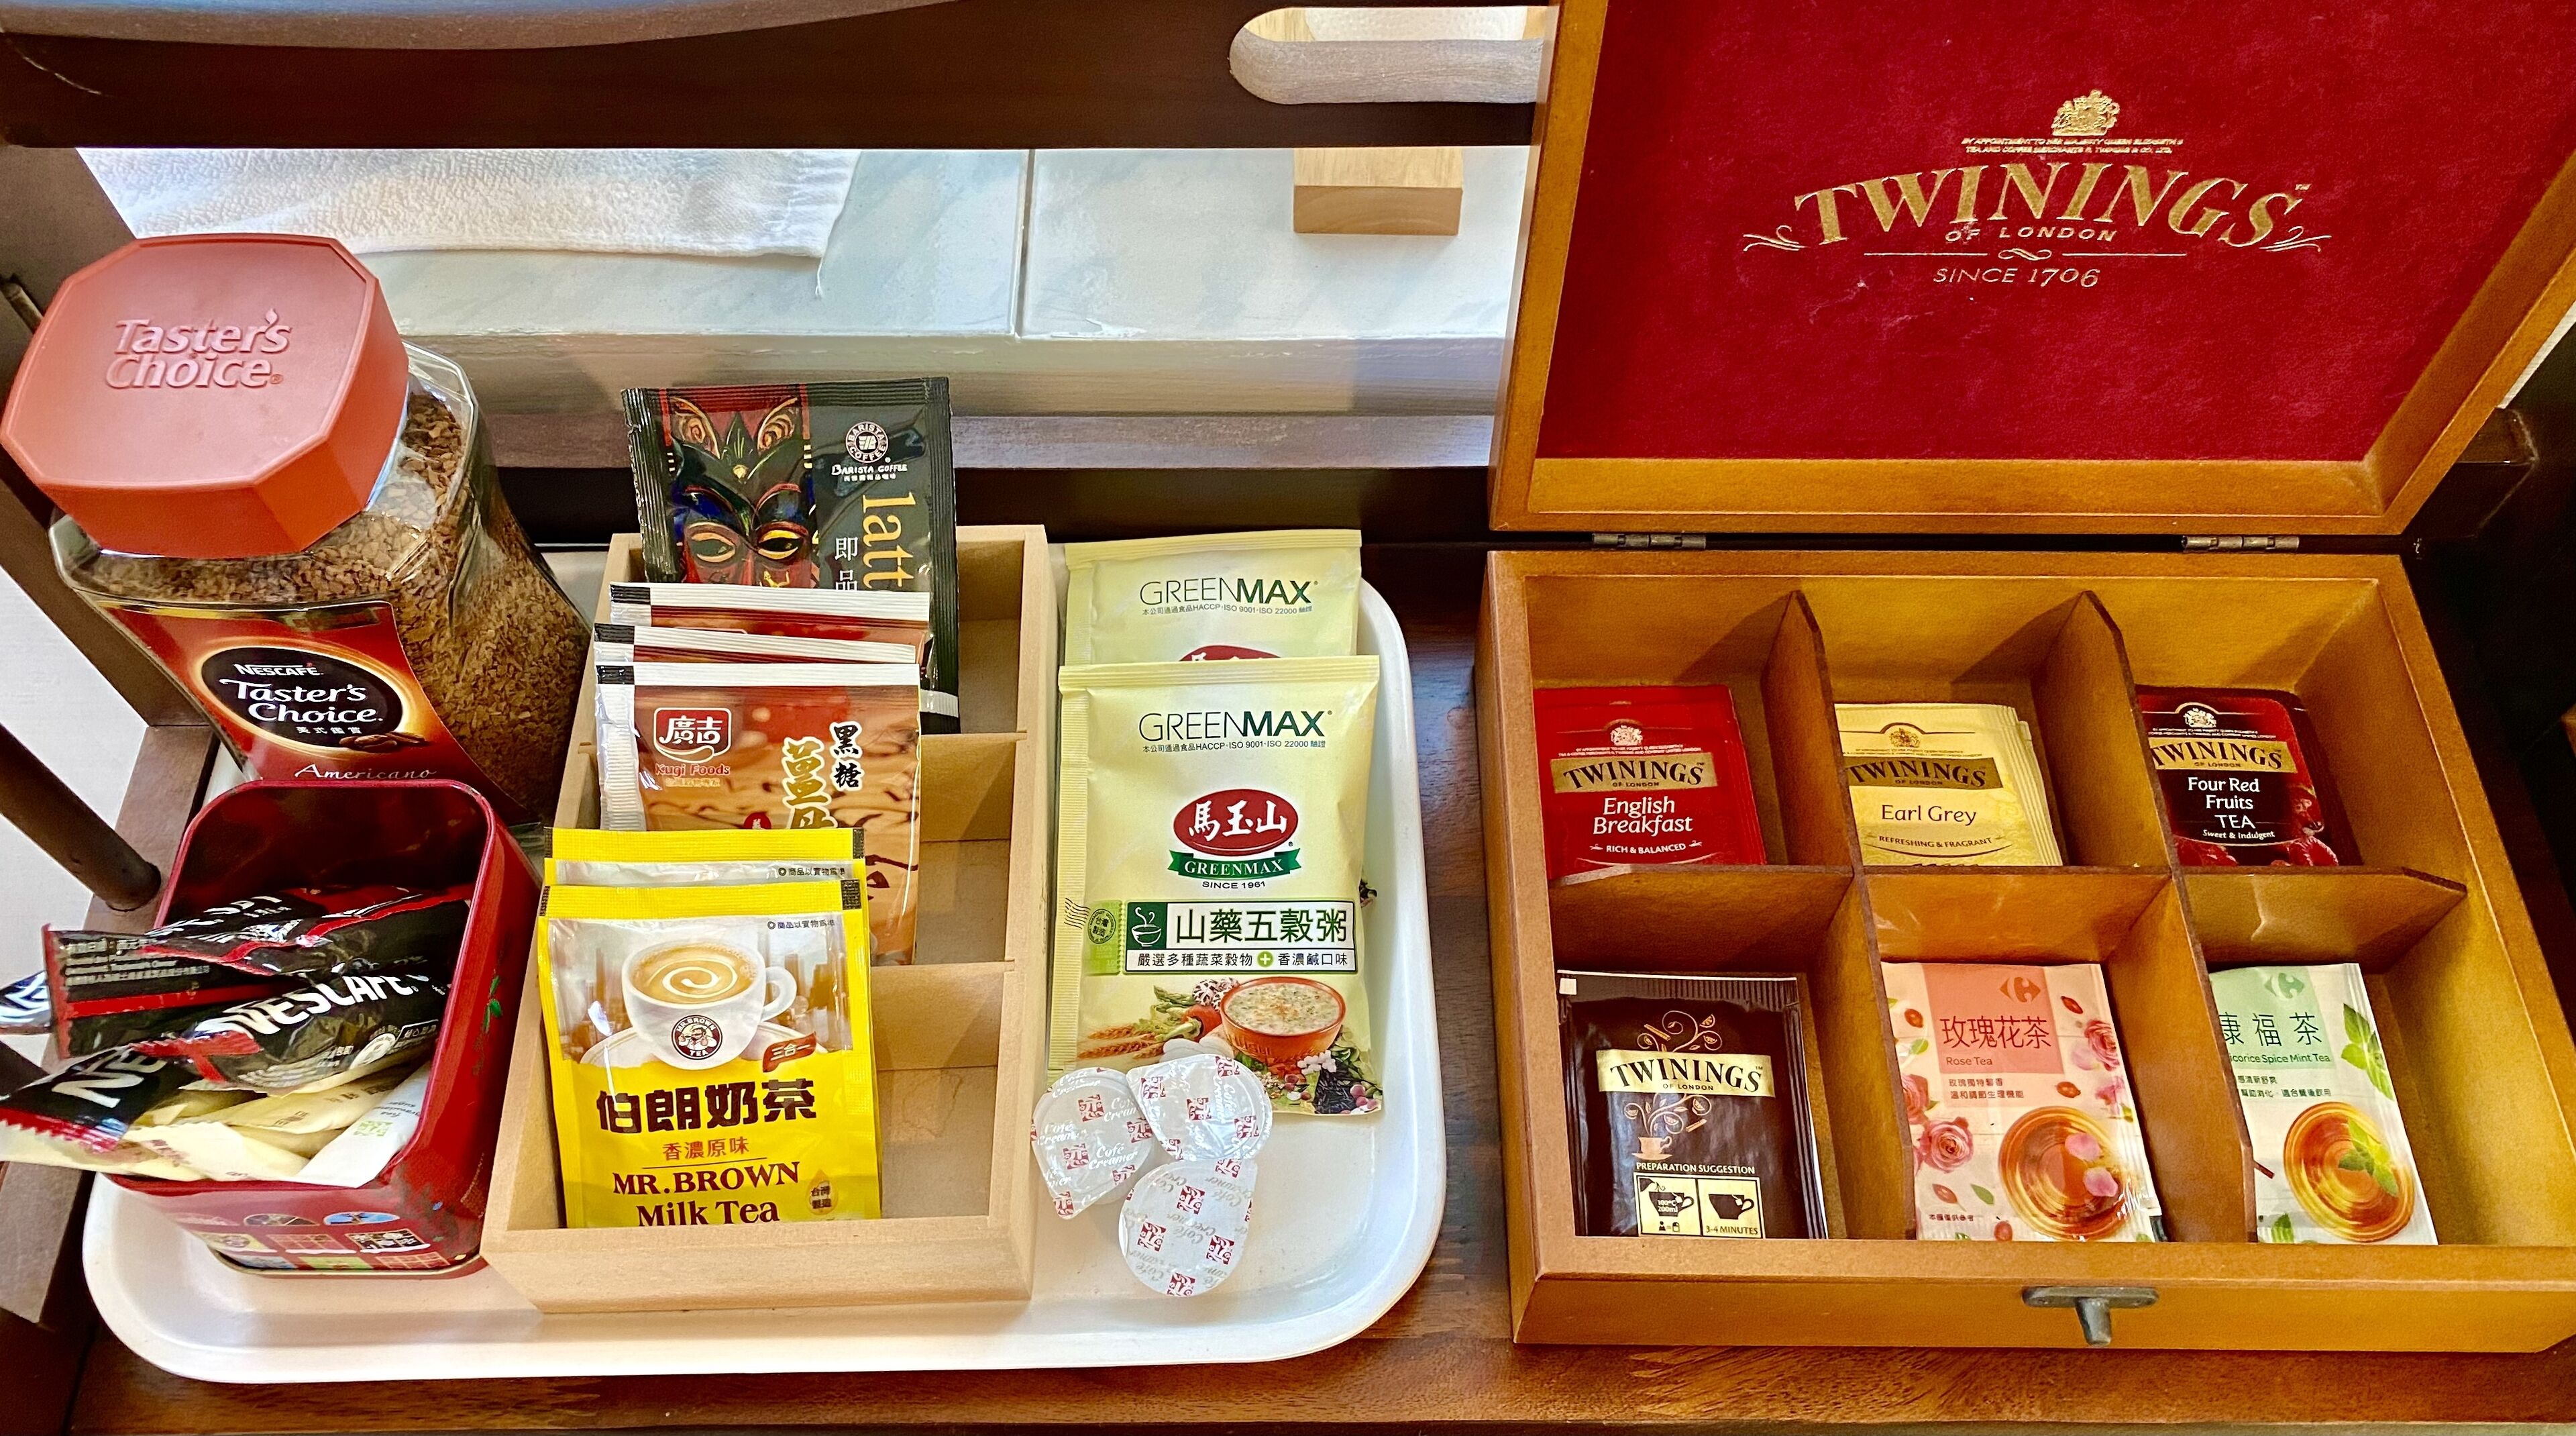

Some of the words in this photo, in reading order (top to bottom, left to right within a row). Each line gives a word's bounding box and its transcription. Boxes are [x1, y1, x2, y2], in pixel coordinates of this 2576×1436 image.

[1794, 162, 2304, 248] TWININGS
[1945, 228, 1980, 242] OF
[1998, 226, 2116, 242] LONDON
[1933, 268, 2017, 283] SINCE
[2027, 268, 2100, 287] 1706
[114, 308, 292, 354] Taster's
[848, 423, 885, 442] BARISTA
[849, 444, 886, 462] COFFEE
[863, 492, 916, 589] latt
[1140, 577, 1312, 605] GREENMAX
[219, 679, 367, 703] Taster's
[659, 715, 723, 745] 廣吉
[1139, 711, 1325, 741] GREENMAX
[833, 725, 860, 788] 黑糖
[2150, 741, 2282, 769] TWININGS
[295, 764, 436, 780] Americano
[690, 764, 731, 776] Foods
[1563, 760, 1703, 789] TWININGS
[1845, 760, 1986, 787] TWININGS
[2188, 777, 2226, 791] Four
[2229, 778, 2260, 792] Red
[1603, 796, 1675, 818] English
[2206, 794, 2253, 810] Fruits
[1189, 800, 1288, 841] 馬玉山
[1593, 815, 1693, 837] Breakfast
[1882, 805, 1921, 821] Earl
[1928, 805, 1976, 826] Grey
[2214, 815, 2255, 829] TEA
[1879, 835, 1935, 848] REFRESHING
[1945, 837, 1992, 848] FRAGRANT
[2203, 829, 2227, 839] Sweet
[1607, 845, 1628, 853] RICH
[1638, 843, 1686, 854] BALANCED
[1184, 859, 1284, 876] GREENMAX
[1202, 881, 1238, 889] SINCE
[1241, 880, 1266, 888] 1961
[1176, 908, 1347, 943] 山藥五穀粥
[1940, 1015, 2051, 1049] 玫瑰花茶
[2219, 1012, 2322, 1047] 康福茶
[771, 1043, 811, 1061] 三合一
[1946, 1057, 1972, 1066] Rose
[1974, 1057, 1993, 1066] Tea
[2230, 1054, 2261, 1063] icorice
[2261, 1054, 2289, 1065] Spice
[2290, 1054, 2312, 1063] Mint
[2312, 1053, 2330, 1062] Tea
[1610, 1058, 1762, 1092] TWININGS
[596, 1078, 817, 1133] 伯朗奶茶
[663, 1137, 749, 1161] 香濃原味
[1636, 1162, 1697, 1173] PREPARATION
[1699, 1165, 1756, 1174] SUGGESTION
[636, 1202, 711, 1227] Milk
[715, 1200, 780, 1224] Tea
[1706, 1225, 1719, 1233] 3-4
[1719, 1226, 1758, 1235] MINUTES
